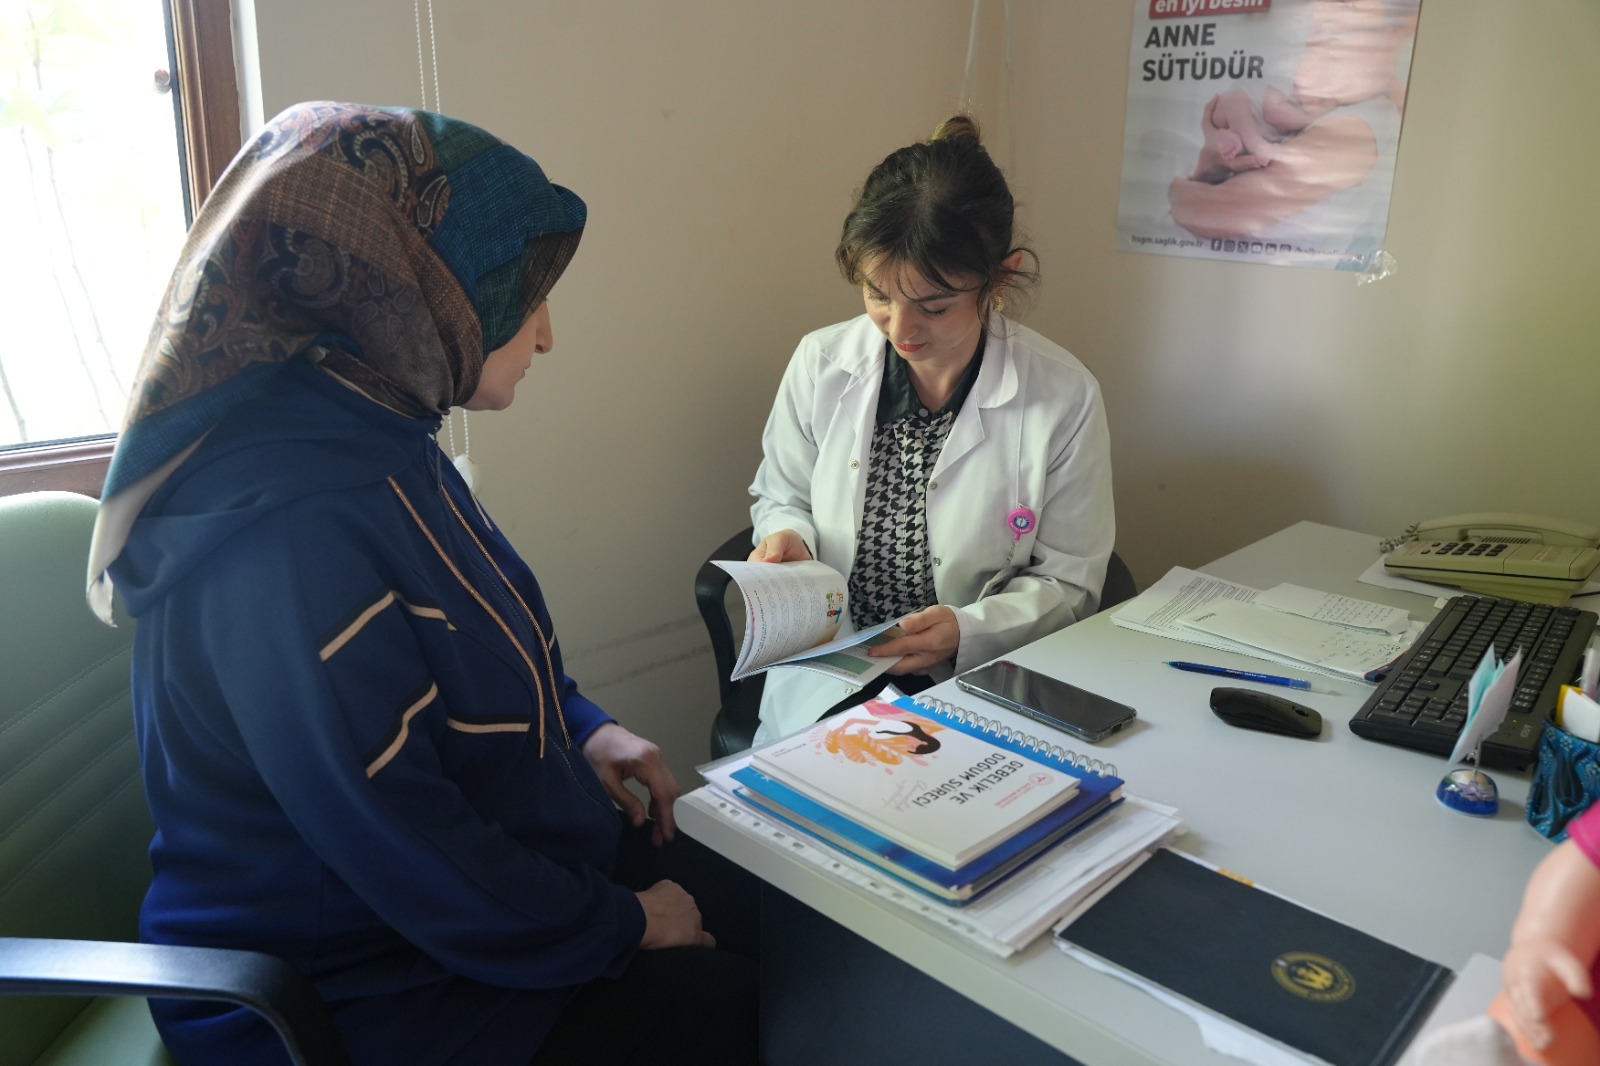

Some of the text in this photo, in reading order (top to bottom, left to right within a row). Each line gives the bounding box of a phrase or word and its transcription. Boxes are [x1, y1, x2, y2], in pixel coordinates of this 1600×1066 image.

[1155, 0, 1178, 13] en
[1144, 23, 1216, 48] ANNE
[1142, 50, 1265, 81] SÜTÜDÜR
[959, 752, 1007, 781] DOĞUM
[968, 760, 1024, 794] GEBELİK
[912, 778, 963, 808] SÜRECİ
[950, 792, 975, 805] VE
